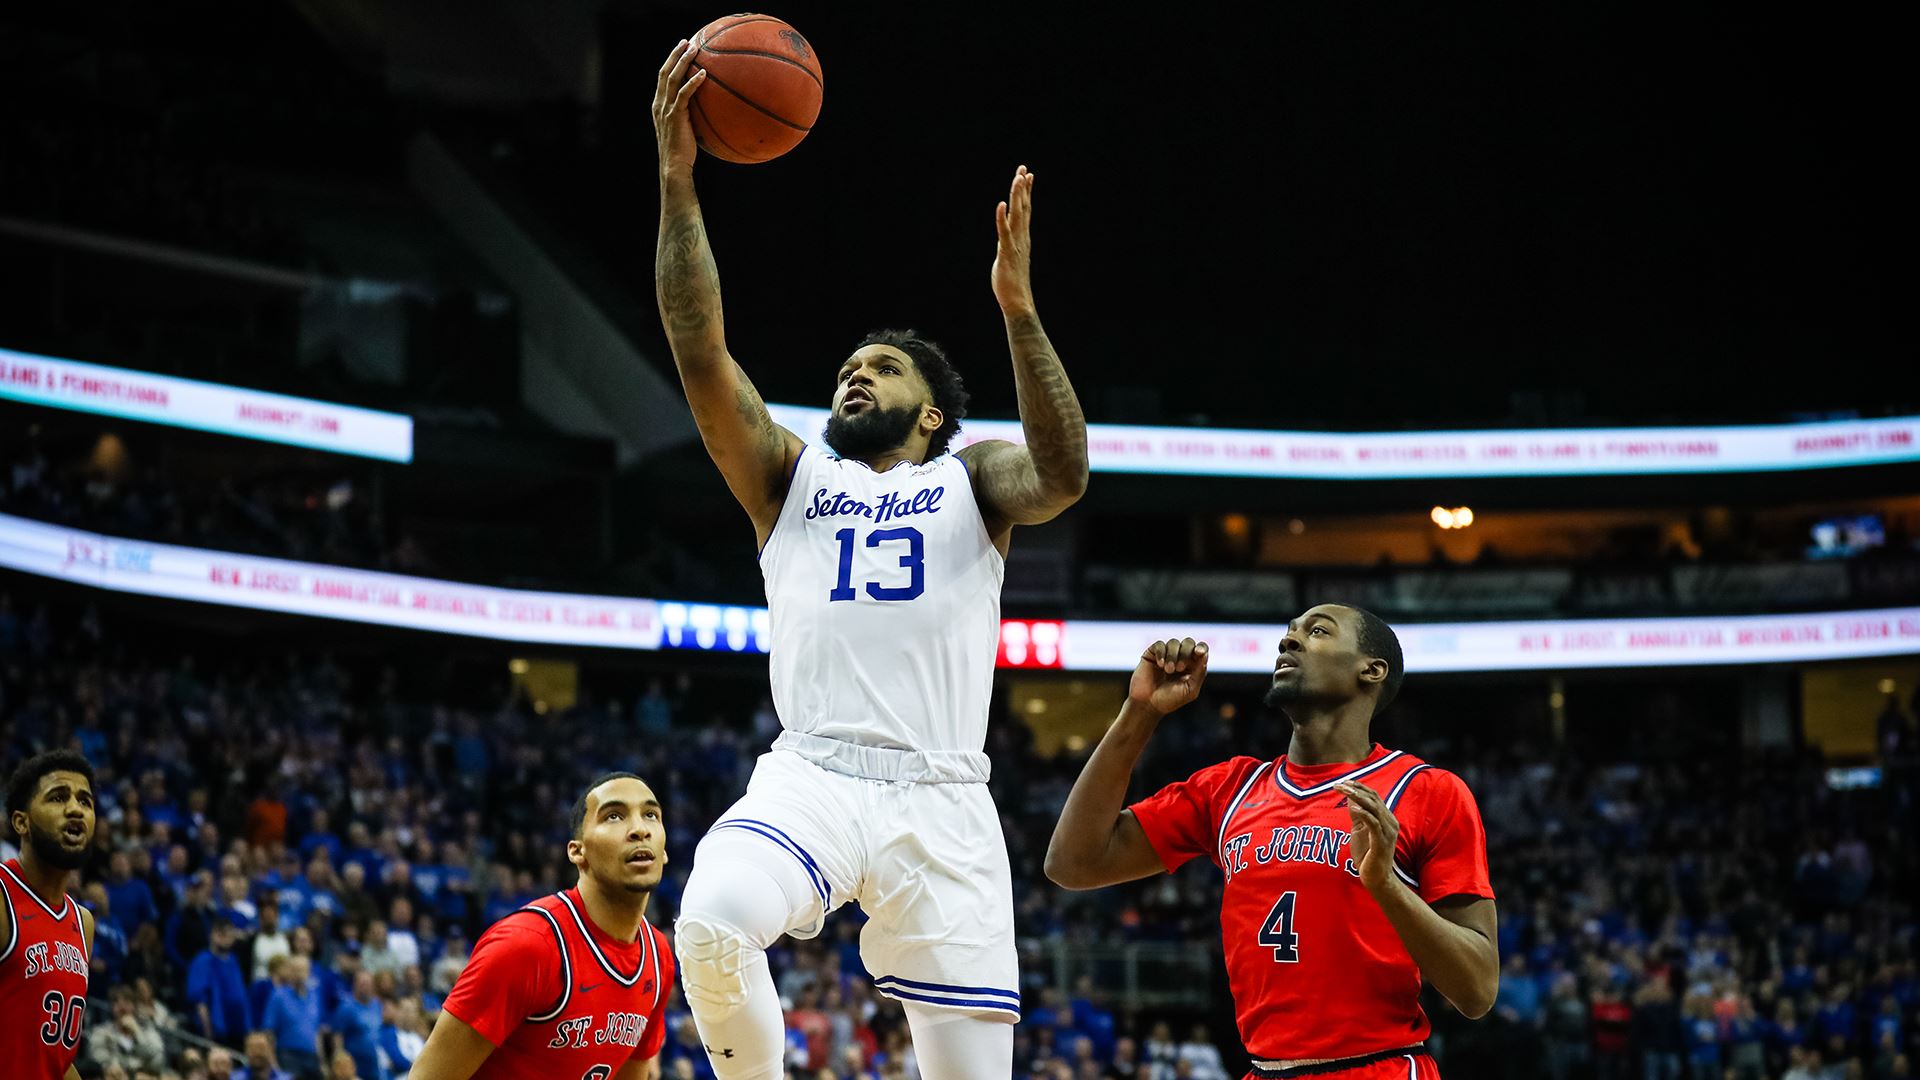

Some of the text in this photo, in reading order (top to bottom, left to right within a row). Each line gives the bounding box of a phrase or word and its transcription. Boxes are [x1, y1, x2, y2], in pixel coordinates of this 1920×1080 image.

[806, 486, 945, 523] Seton Hall
[830, 526, 925, 602] 13
[1223, 832, 1252, 885] ST.
[1257, 891, 1299, 963] 4
[25, 941, 54, 979] ST.
[40, 989, 87, 1051] 30
[548, 1015, 594, 1049] ST.
